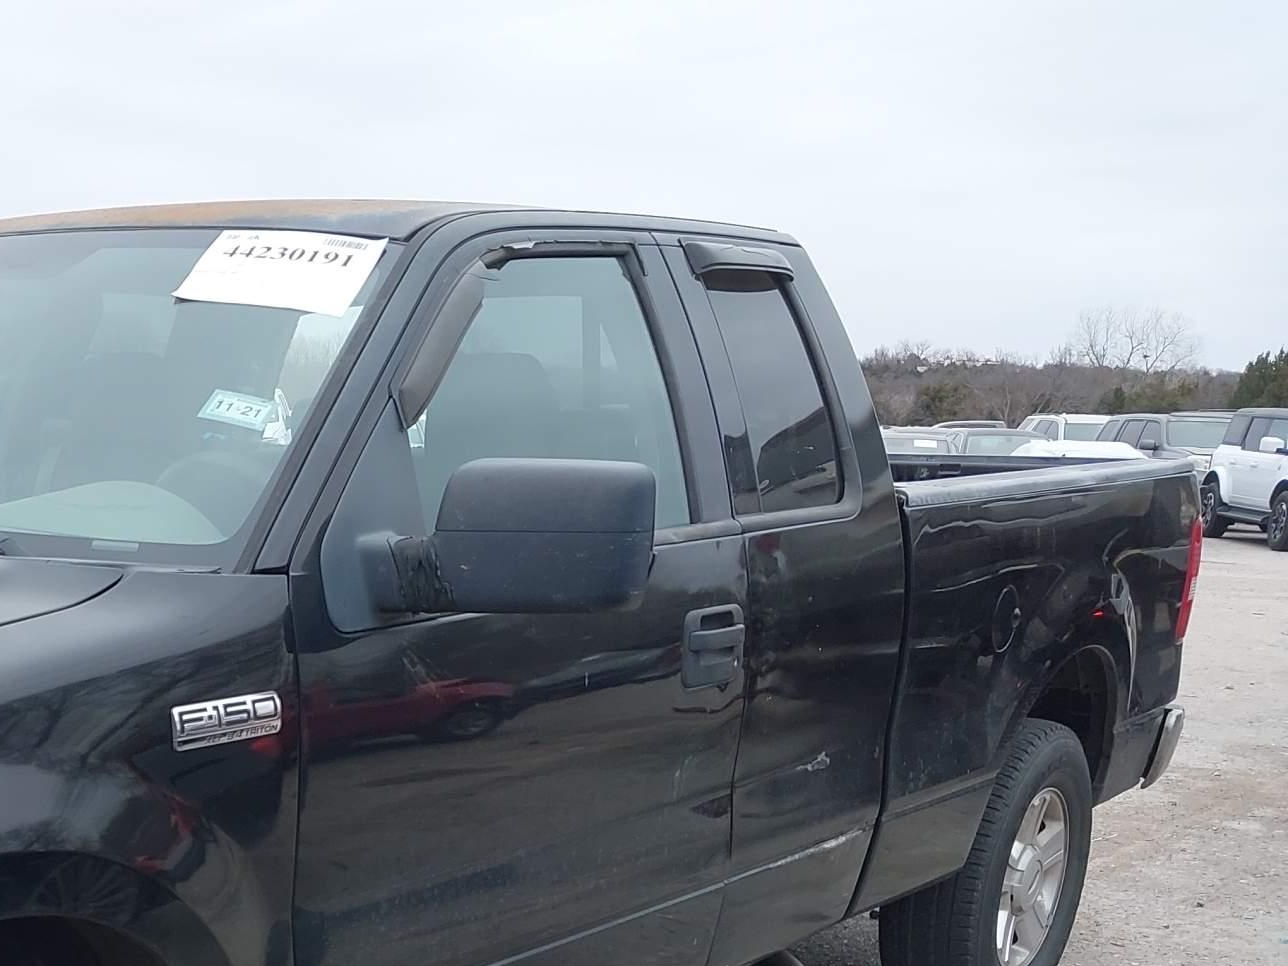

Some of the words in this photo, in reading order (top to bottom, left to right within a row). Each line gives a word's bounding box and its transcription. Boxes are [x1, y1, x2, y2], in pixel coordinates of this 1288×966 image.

[223, 245, 354, 267] 44230191
[178, 695, 278, 735] F-150
[245, 724, 279, 739] TRITON
